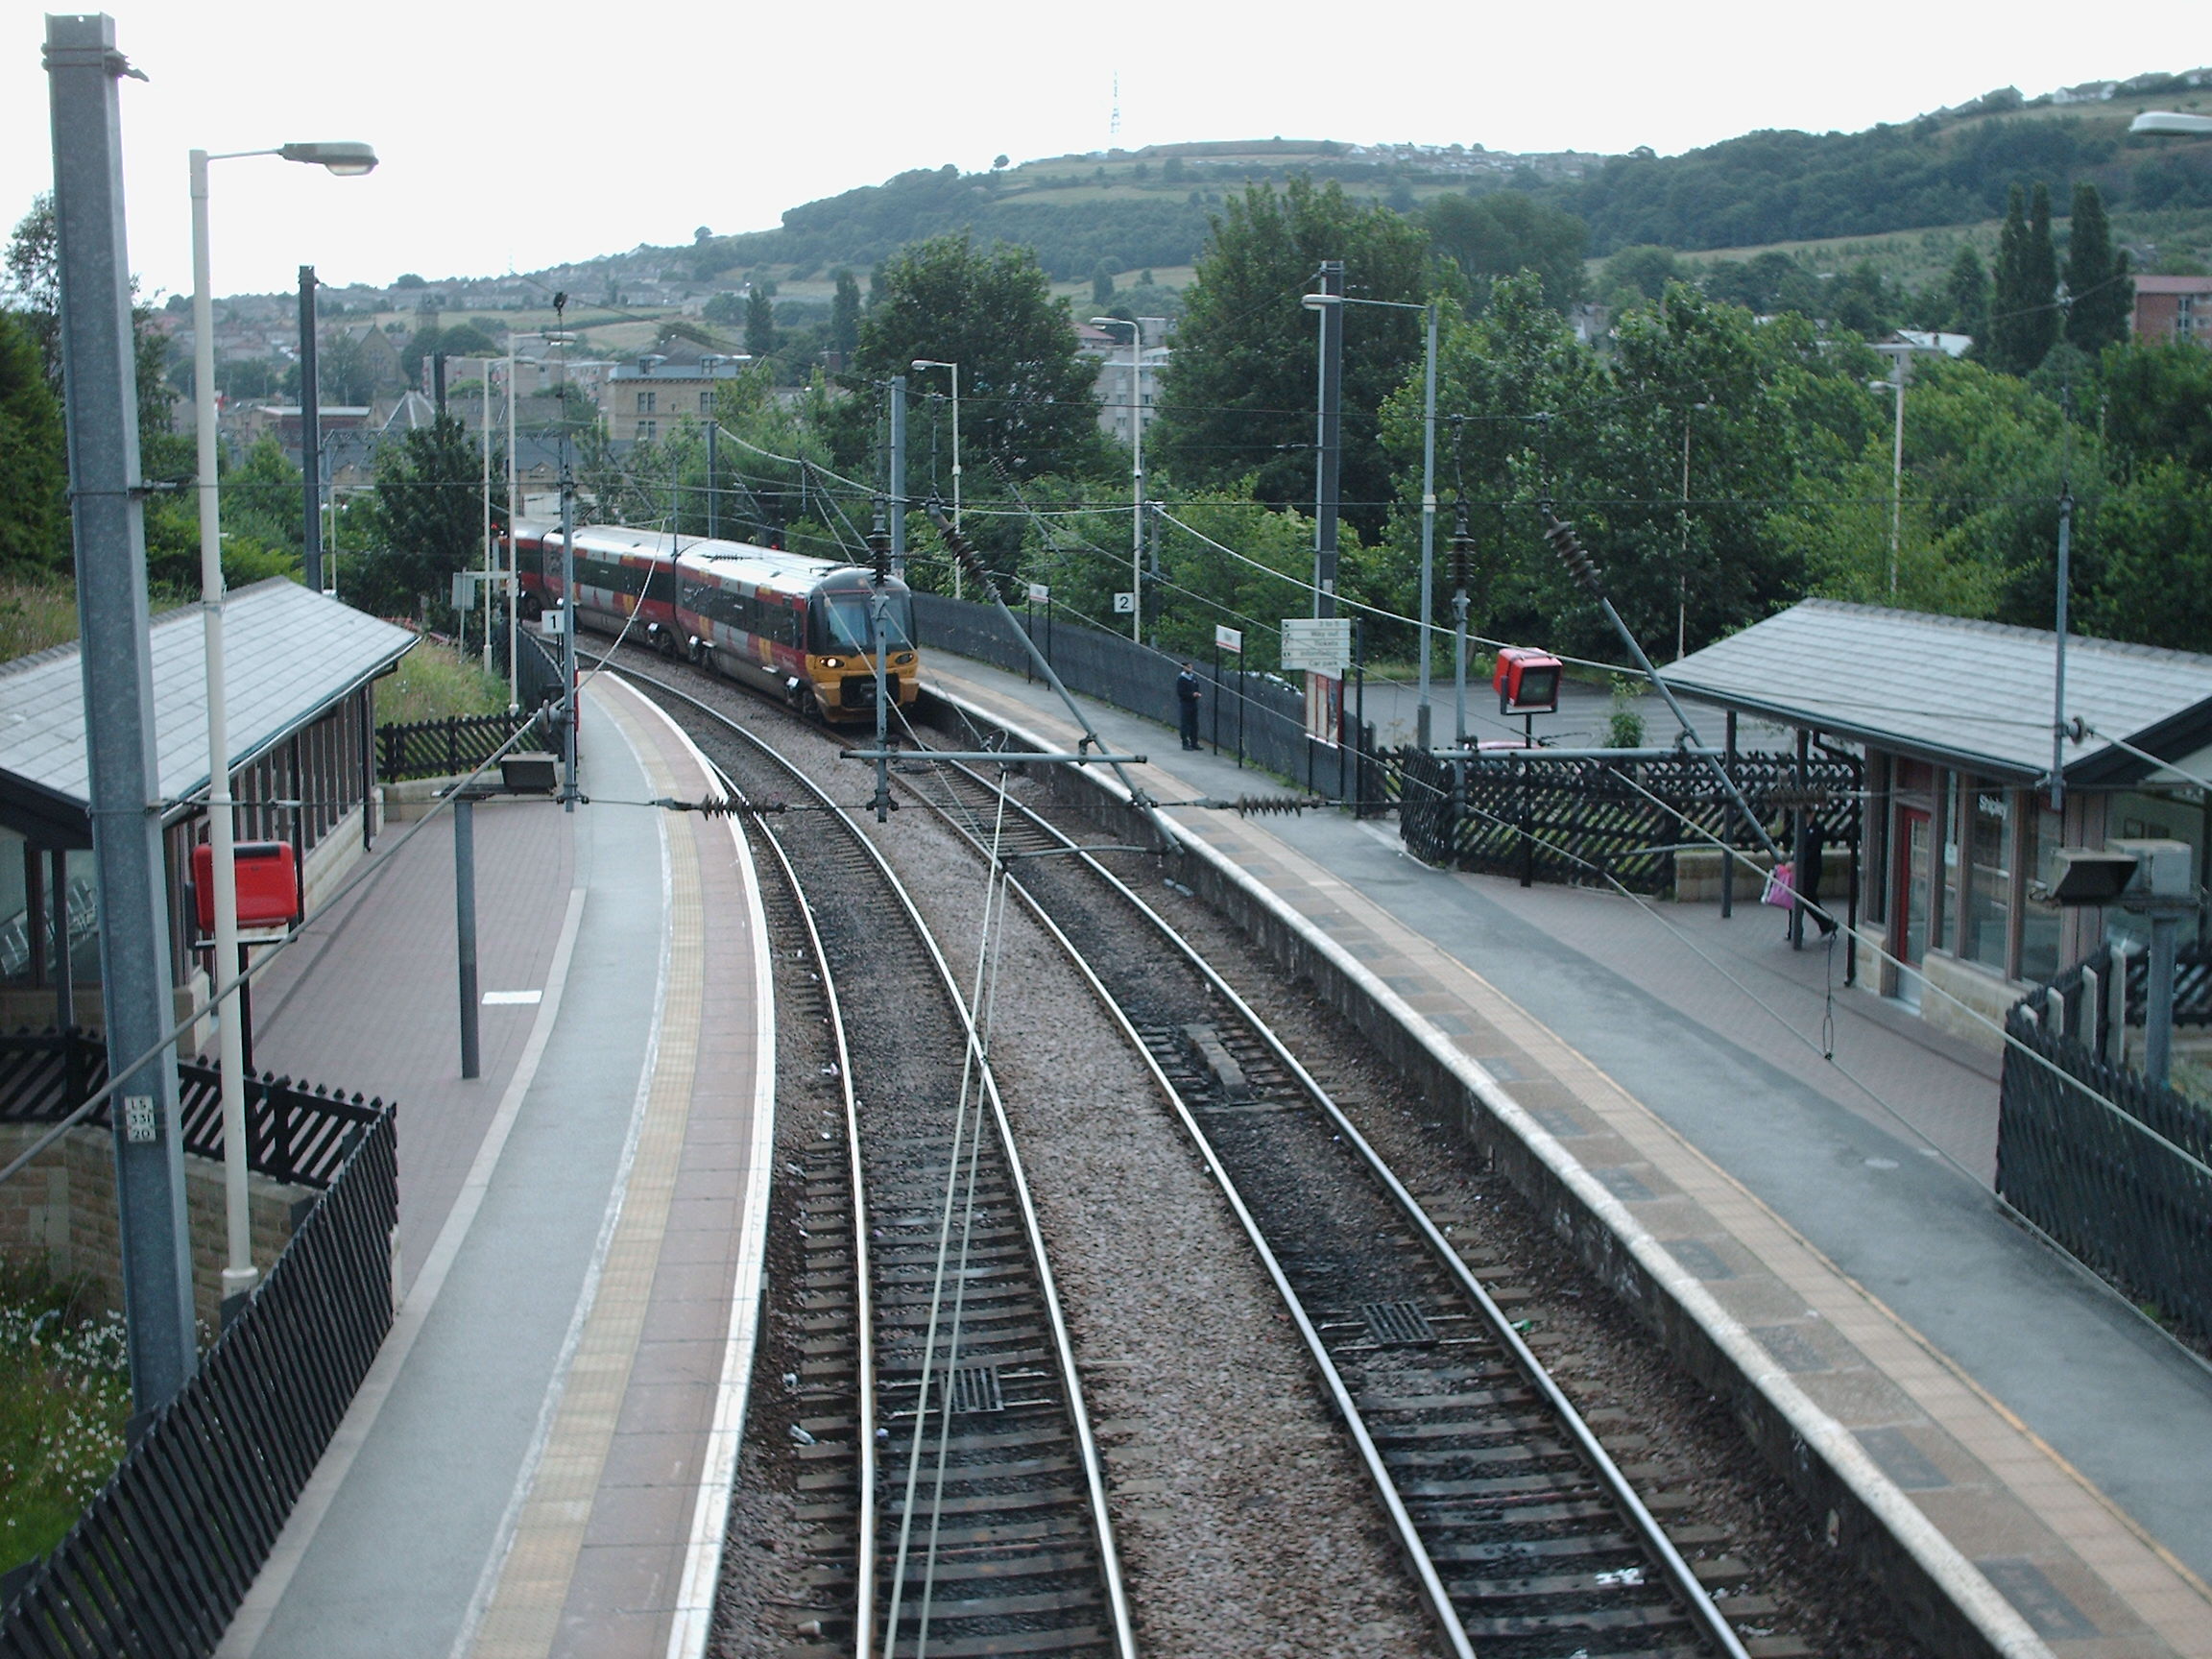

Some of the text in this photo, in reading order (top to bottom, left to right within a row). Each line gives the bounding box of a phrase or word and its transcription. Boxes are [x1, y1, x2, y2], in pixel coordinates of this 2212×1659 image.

[1119, 596, 1129, 610] 2
[550, 614, 556, 629] 1
[132, 1128, 151, 1140] 20
